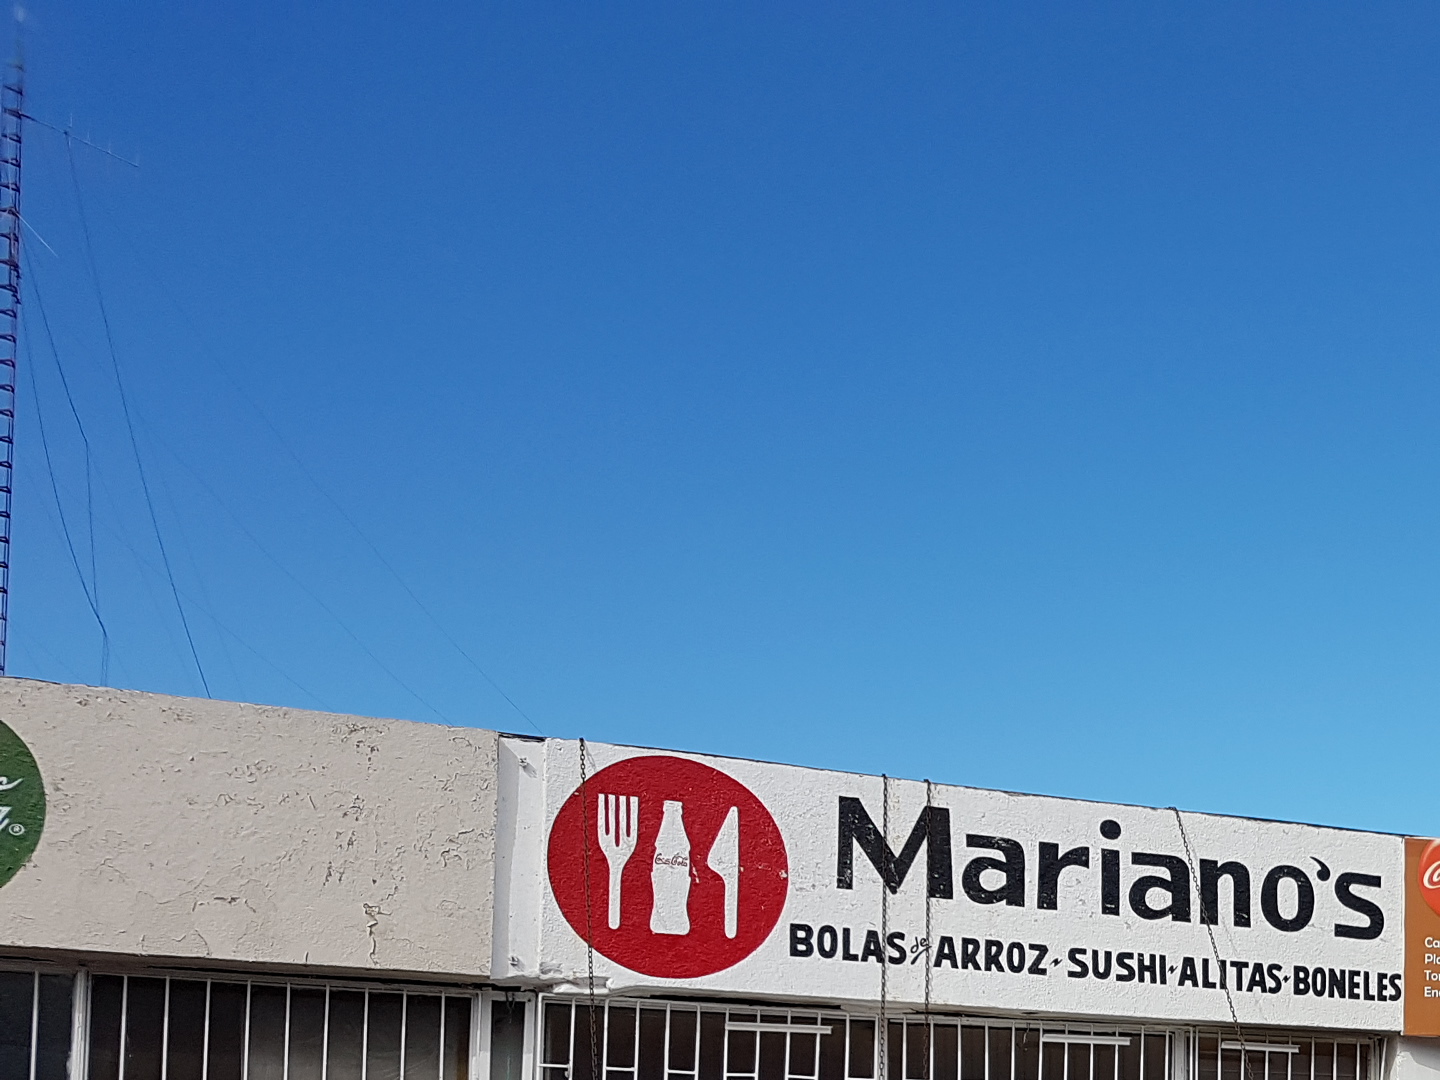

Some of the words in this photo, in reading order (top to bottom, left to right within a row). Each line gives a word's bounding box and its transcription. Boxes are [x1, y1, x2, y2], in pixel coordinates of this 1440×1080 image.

[836, 795, 1385, 940] Mariano's
[789, 922, 907, 965] BOLAS
[933, 935, 1048, 976] ARROZ
[1067, 946, 1167, 986] SUSHI
[1177, 956, 1285, 994] ALITAS
[1293, 965, 1402, 1002] BONELES
